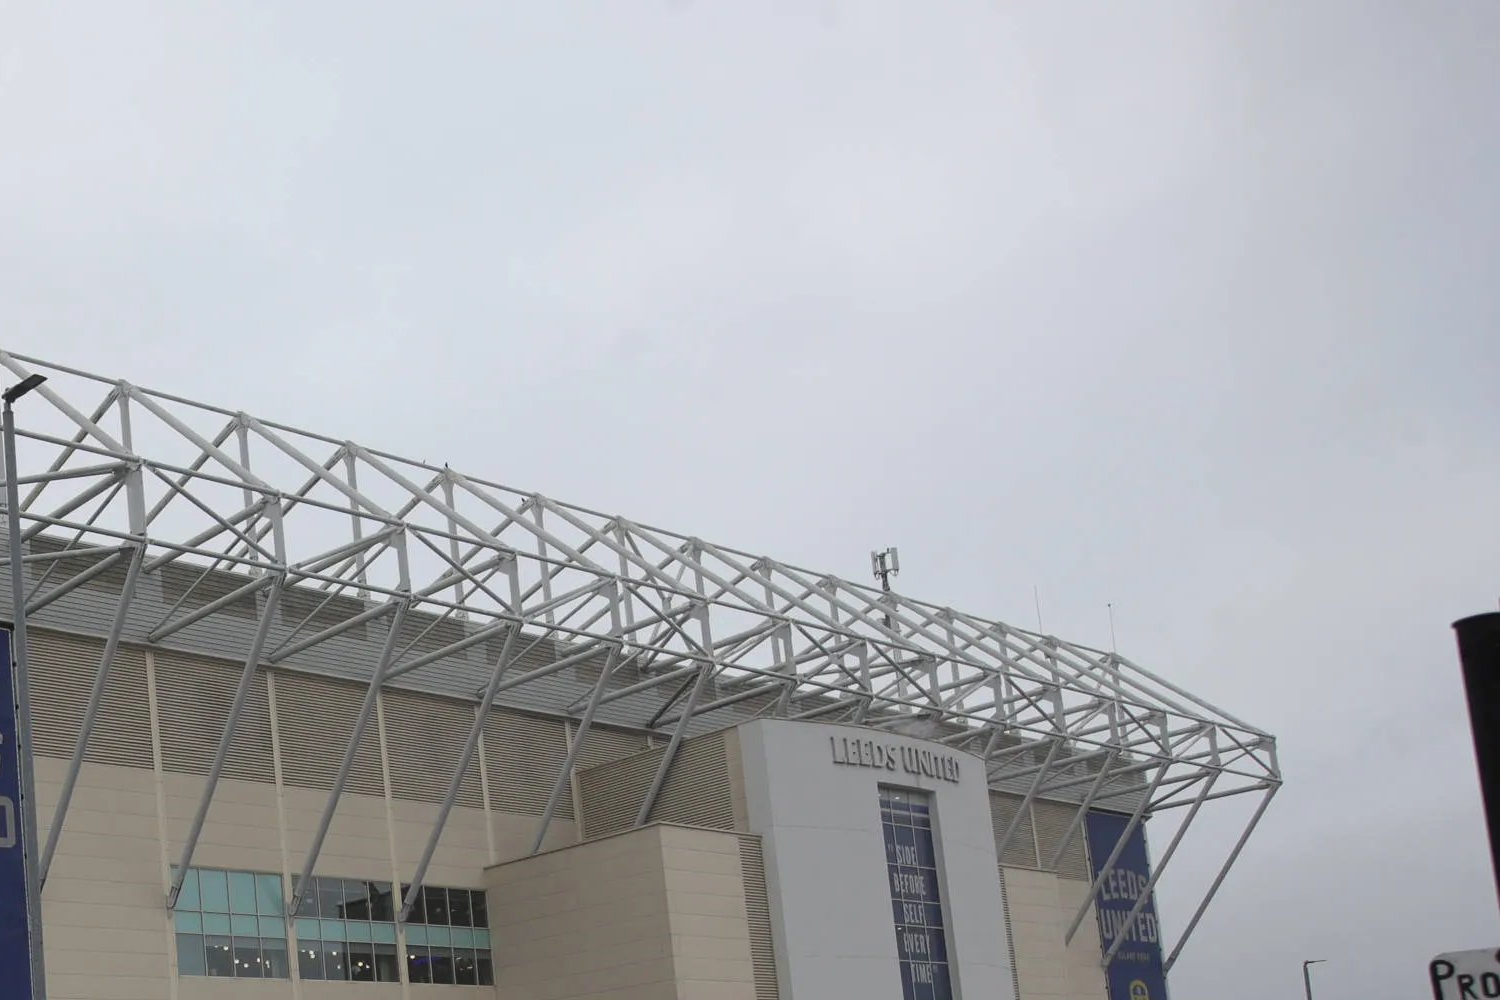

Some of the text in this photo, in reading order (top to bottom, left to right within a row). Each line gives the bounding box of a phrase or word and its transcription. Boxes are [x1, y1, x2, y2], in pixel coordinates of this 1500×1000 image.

[830, 736, 960, 784] LEEDS UNITED
[893, 871, 927, 896] BEFORE
[903, 932, 930, 955] EVERY
